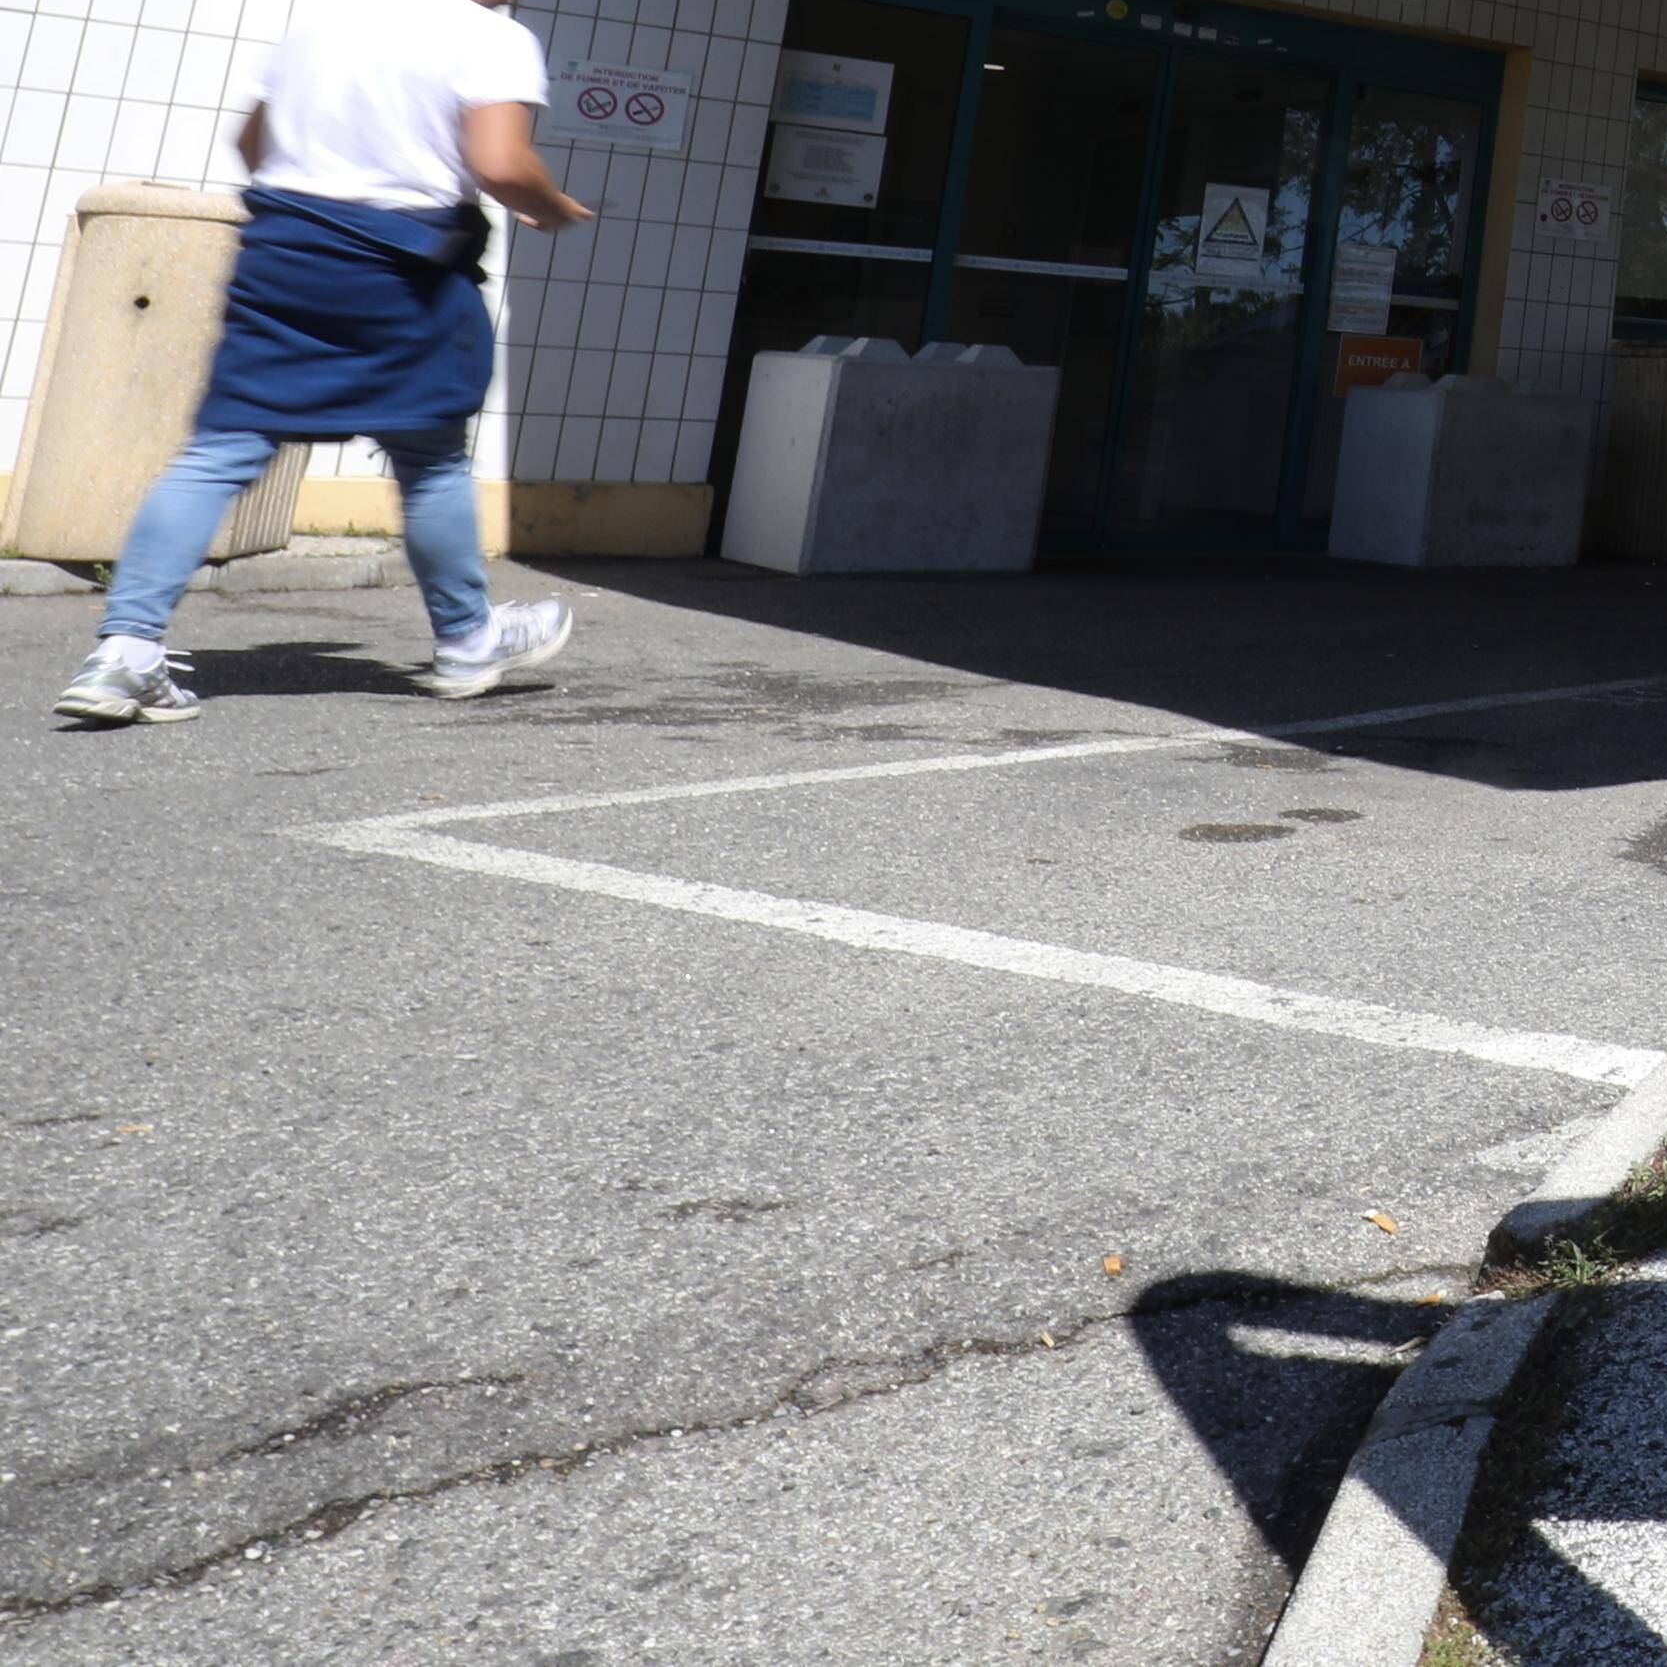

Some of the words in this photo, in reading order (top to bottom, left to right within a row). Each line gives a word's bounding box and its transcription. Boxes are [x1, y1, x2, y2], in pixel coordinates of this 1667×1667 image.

[592, 66, 659, 83] INTERDICTION
[560, 72, 572, 82] DE
[575, 75, 610, 86] FUMER
[612, 79, 625, 88] ET
[626, 81, 639, 89] DE
[642, 82, 687, 95] VAPOTER
[1348, 353, 1399, 370] ENTRÉE
[1401, 357, 1411, 370] A
